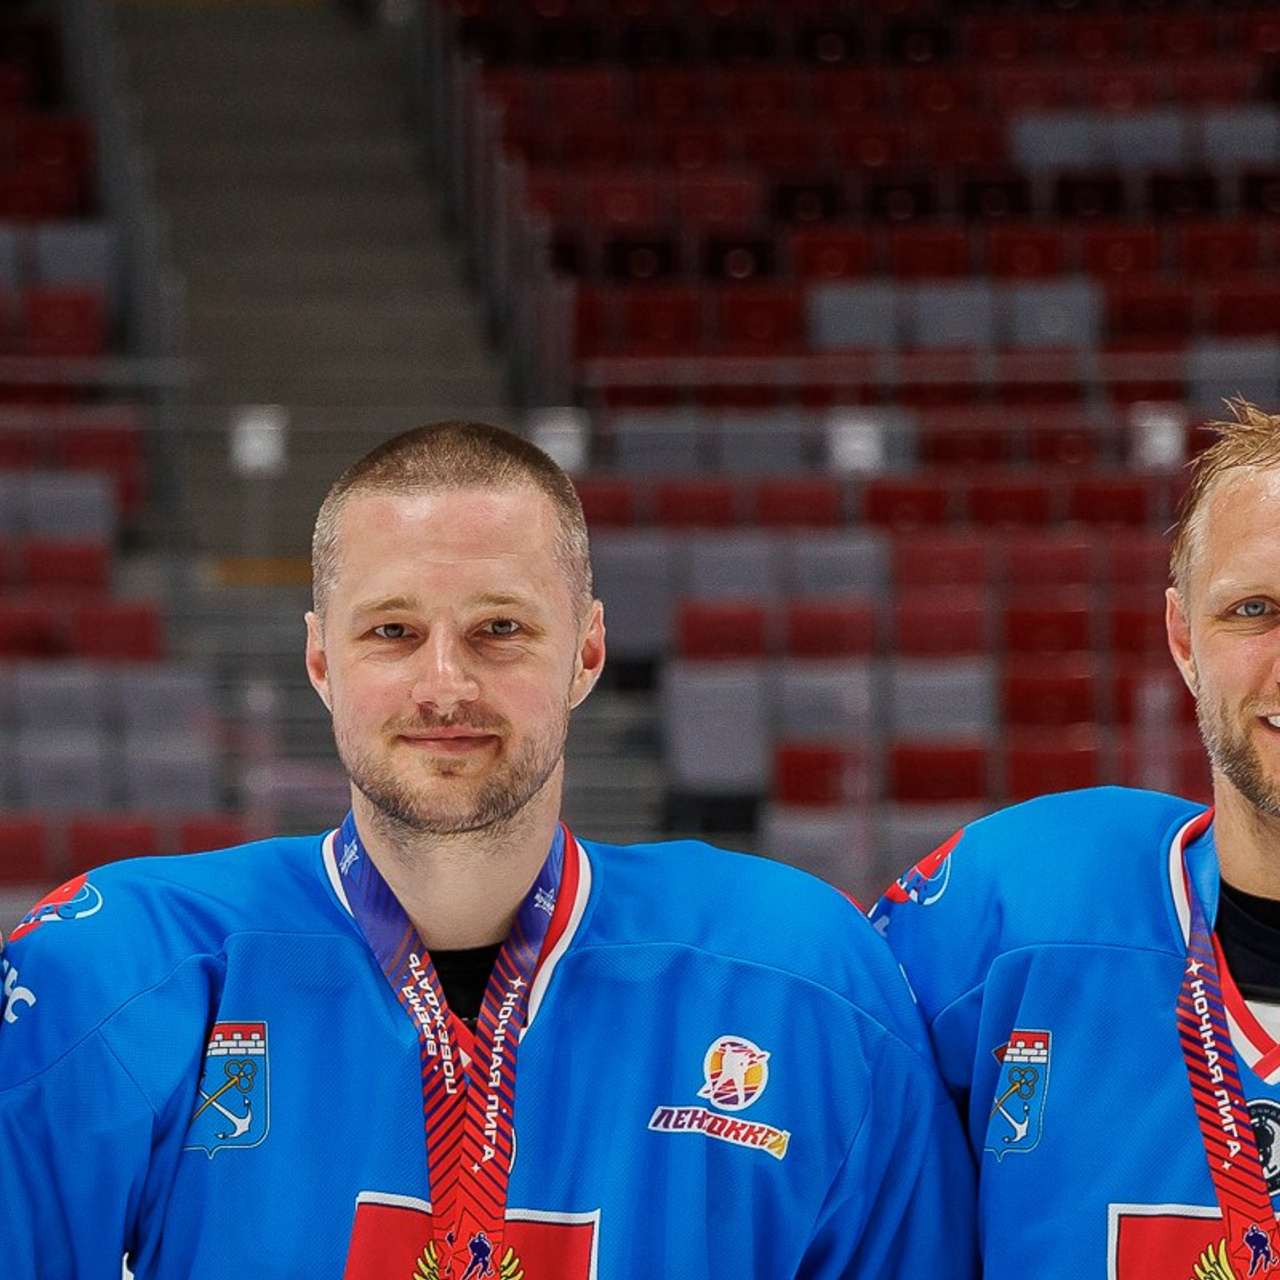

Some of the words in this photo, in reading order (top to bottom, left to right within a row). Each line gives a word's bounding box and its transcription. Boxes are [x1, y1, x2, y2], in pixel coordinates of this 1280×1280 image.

[402, 986, 438, 1056] ВРЕМЯ
[408, 953, 458, 1094] ПОБЕЖДАТЬ
[487, 992, 519, 1087] НОЧНАЯ
[1190, 979, 1224, 1084] НОЧНАЯ
[1214, 1089, 1241, 1158] ЛИГА
[481, 1094, 499, 1162] ЛИГА
